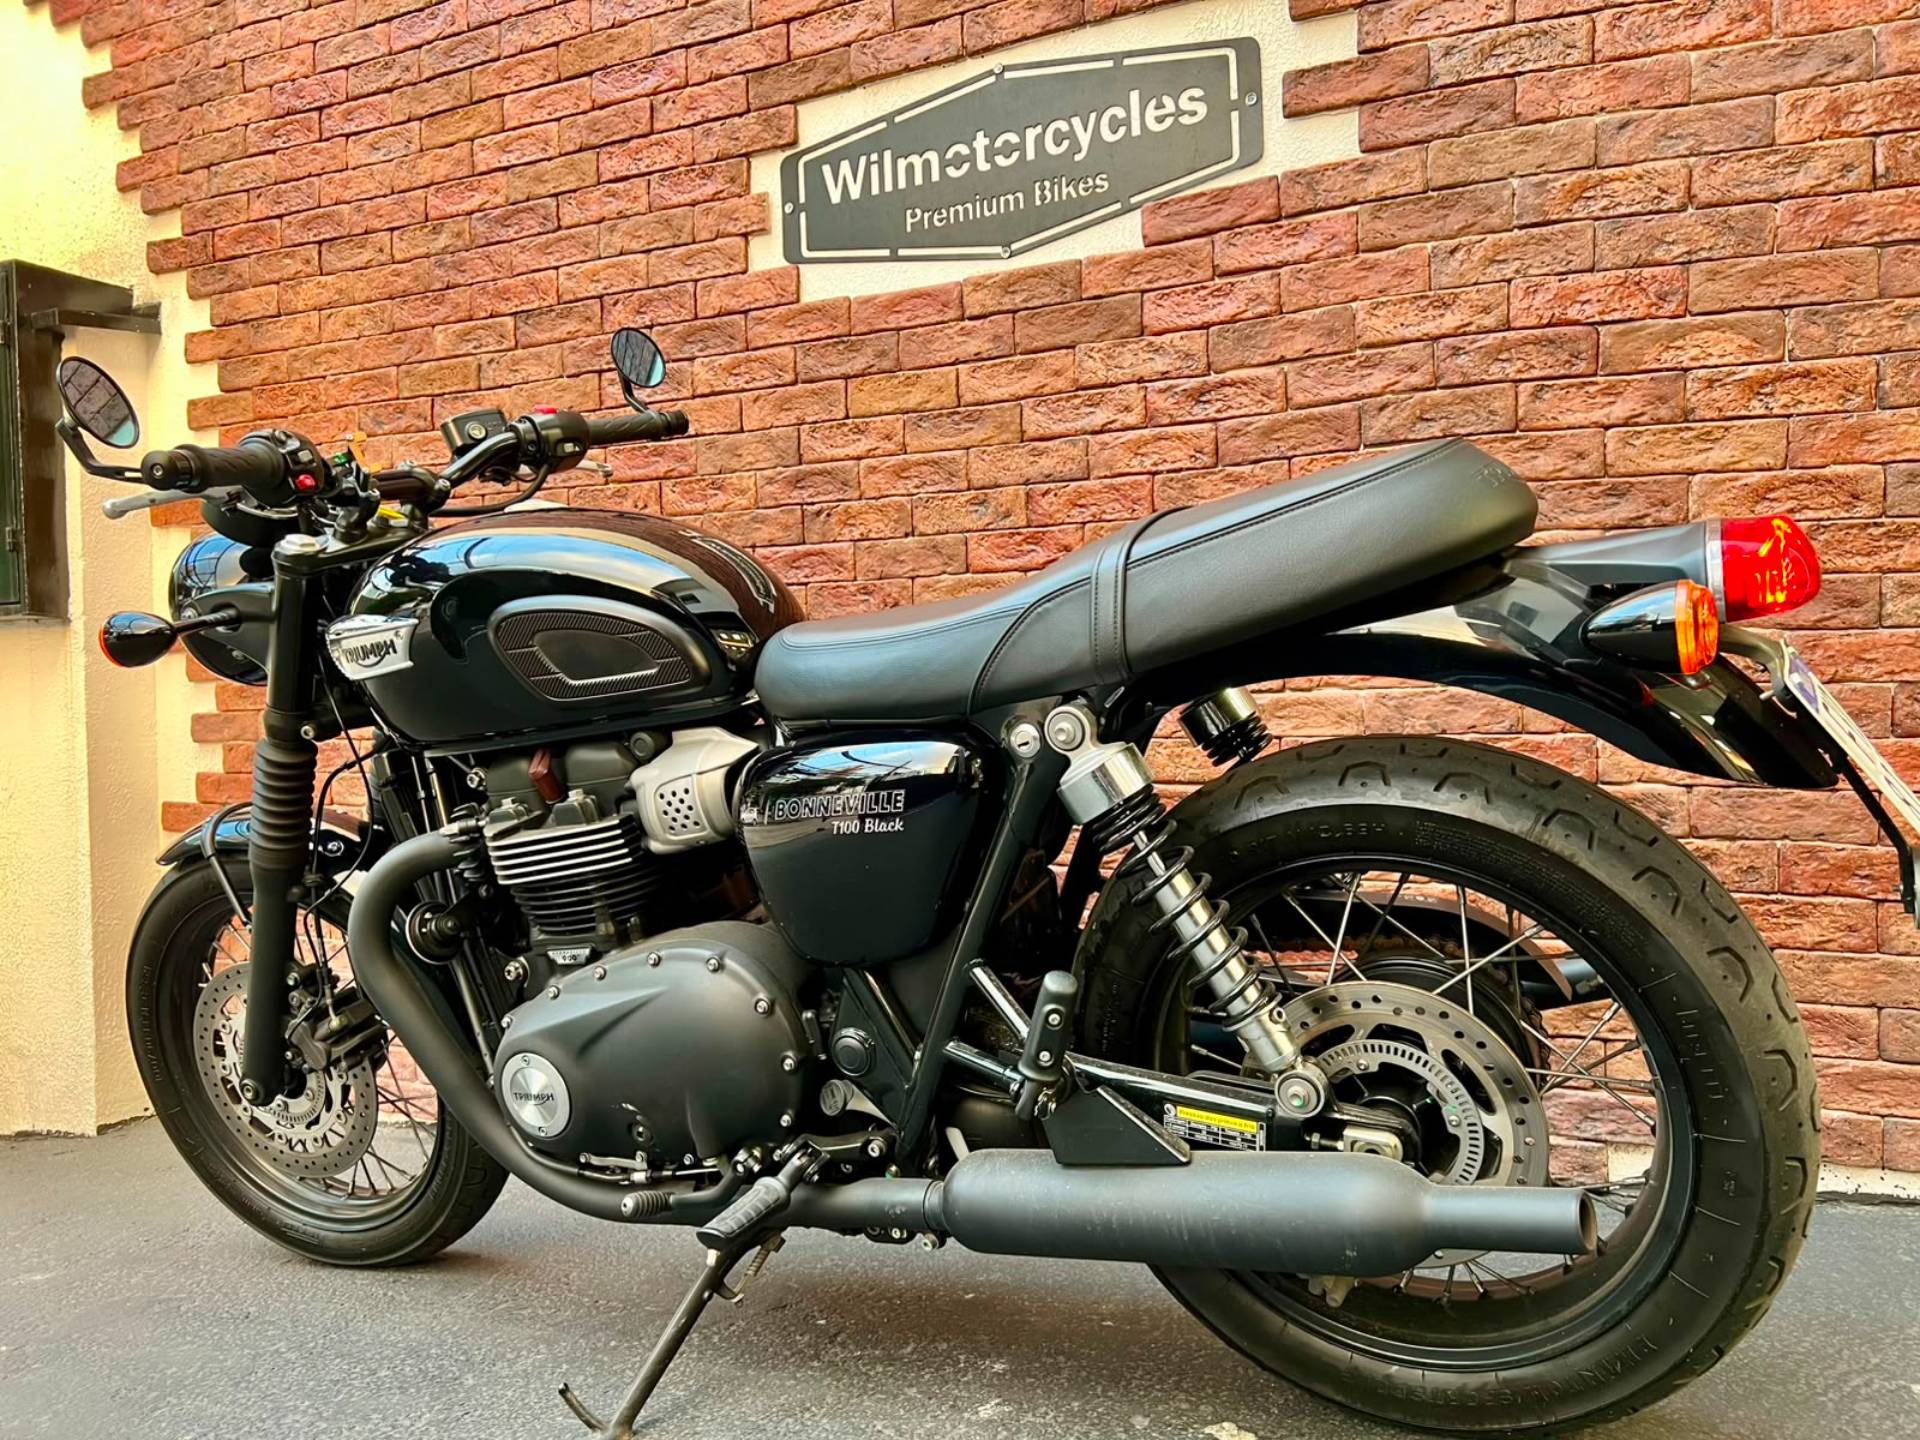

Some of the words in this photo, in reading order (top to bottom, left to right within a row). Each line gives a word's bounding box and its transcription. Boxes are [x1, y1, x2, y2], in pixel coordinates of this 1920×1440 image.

[821, 85, 1209, 204] Wilmotorcycles
[904, 188, 1025, 234] Premium
[1033, 171, 1111, 207] Bikes
[341, 638, 397, 665] TRIUMPH
[774, 789, 906, 821] BONNEVILLE
[831, 819, 860, 835] T100
[864, 817, 904, 834] Black
